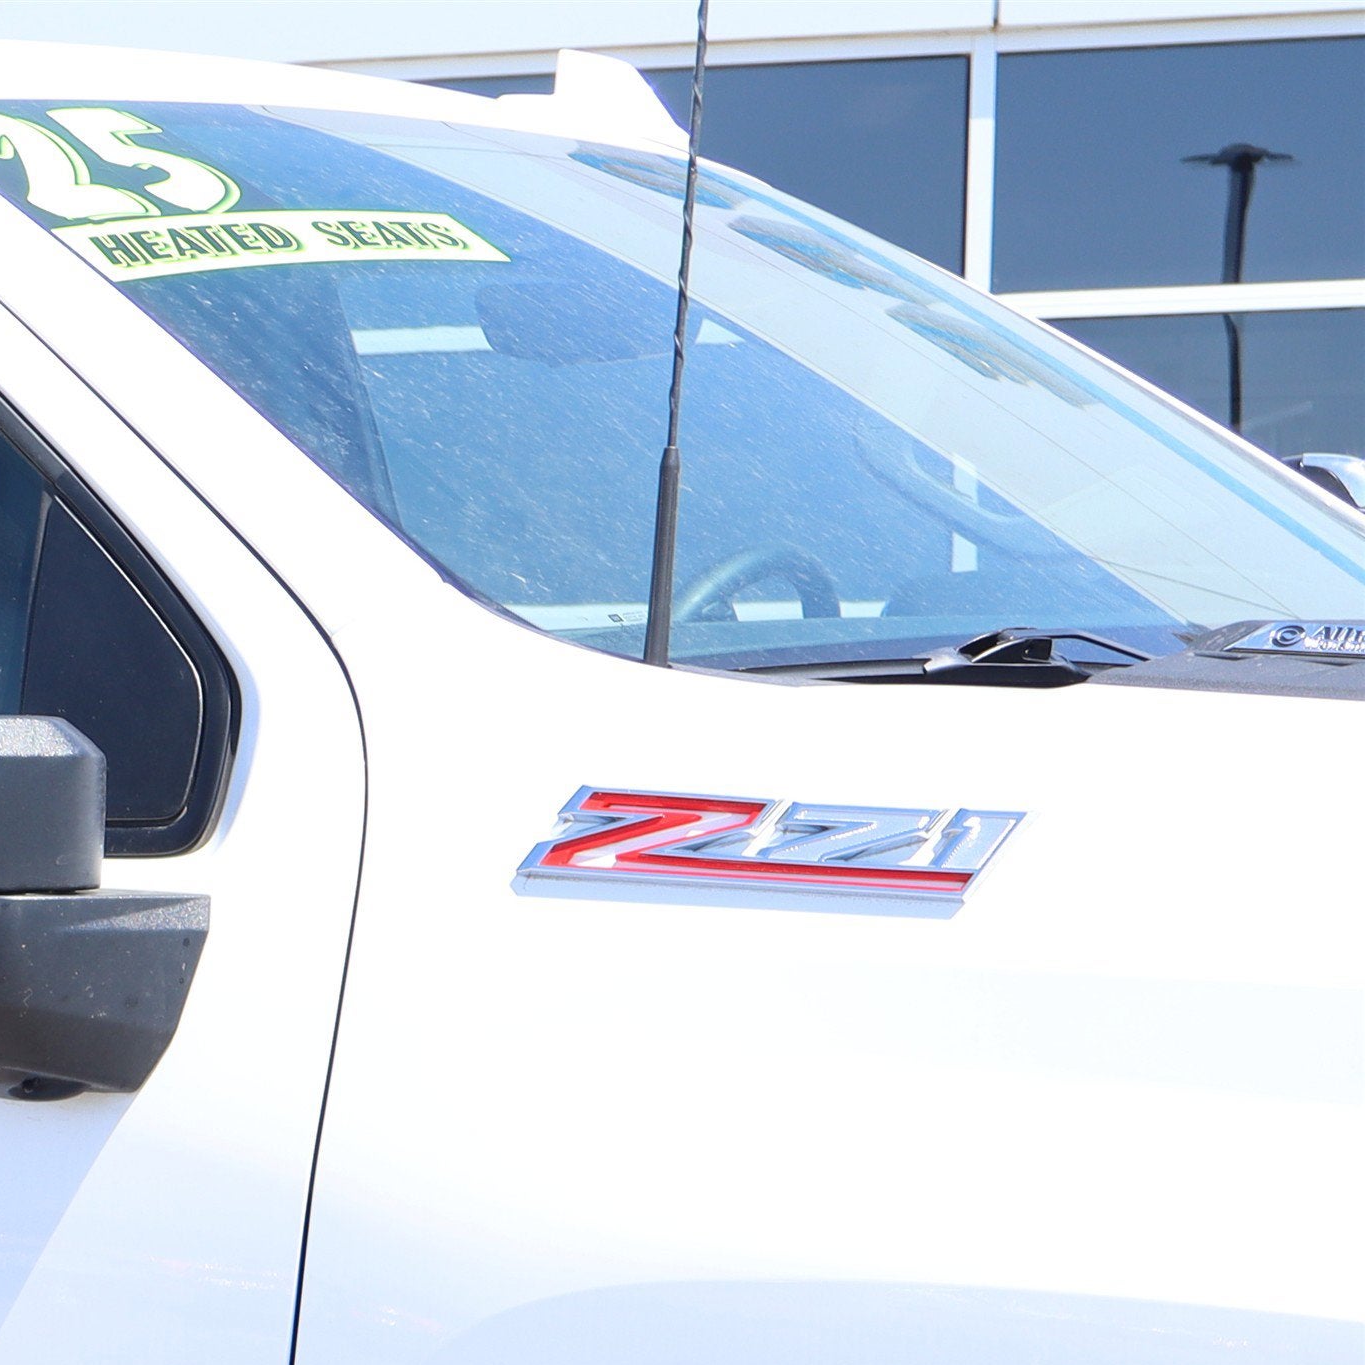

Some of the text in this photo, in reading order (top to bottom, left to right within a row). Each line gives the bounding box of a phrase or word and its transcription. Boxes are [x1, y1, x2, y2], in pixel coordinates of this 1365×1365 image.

[88, 220, 468, 268] HEATED SEATS
[1312, 625, 1365, 641] Alli
[514, 785, 1029, 902] Z71
